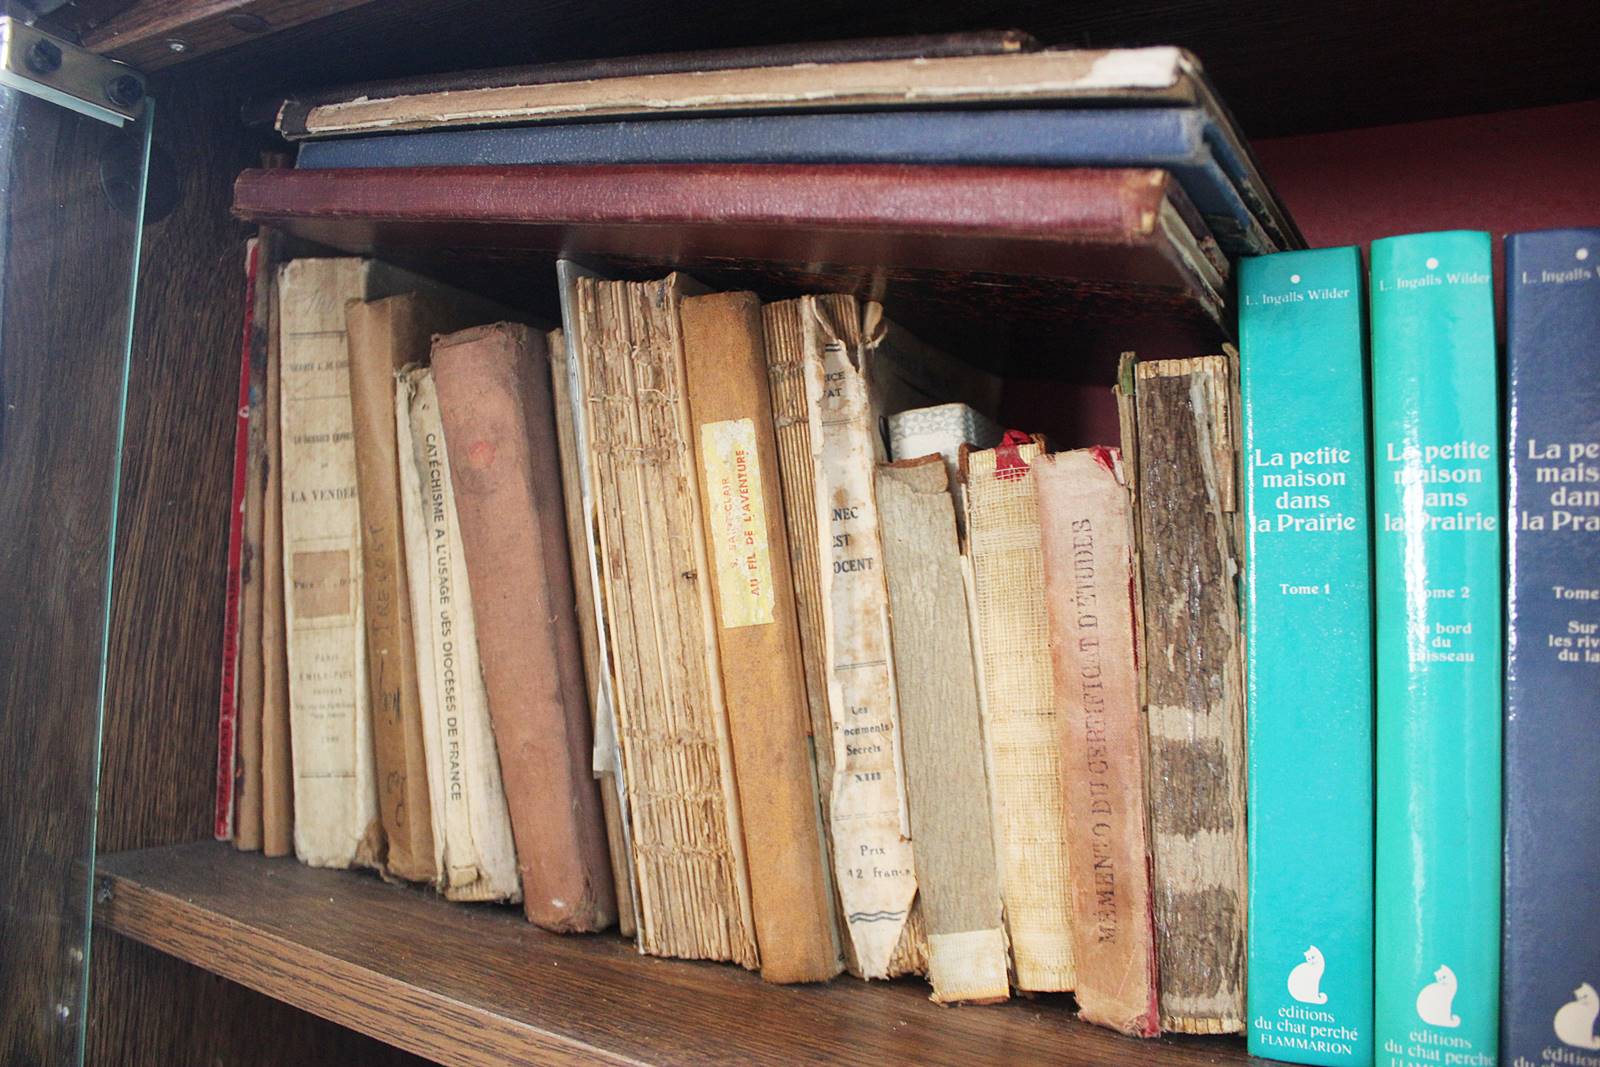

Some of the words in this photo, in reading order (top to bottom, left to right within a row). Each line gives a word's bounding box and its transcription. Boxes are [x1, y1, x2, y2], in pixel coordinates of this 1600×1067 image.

[1397, 273, 1442, 289] Ingalls
[1446, 272, 1490, 285] Wilder
[1263, 291, 1303, 305] Ingalls
[1308, 288, 1350, 300] Wilder
[1255, 449, 1283, 466] La
[1290, 447, 1350, 469] petite
[1424, 441, 1490, 463] petite
[1528, 439, 1561, 459] La
[425, 433, 445, 522] CATÉCHISME
[1263, 470, 1345, 488] maison
[1536, 462, 1600, 483] mais
[736, 449, 753, 522] L'AVENTURE
[1276, 492, 1330, 509] dans
[1550, 486, 1600, 506] dan
[1277, 513, 1356, 532] Prairie
[1384, 512, 1404, 531] la
[1521, 510, 1544, 530] la
[434, 528, 445, 539] A
[745, 530, 754, 545] DE
[748, 552, 758, 570] FIL
[436, 544, 450, 604] L'USAGE
[750, 578, 760, 596] AU
[1279, 583, 1319, 595] Tome
[1324, 583, 1330, 595] 1
[1461, 586, 1470, 598] 2
[1552, 586, 1600, 599] Tome
[1436, 622, 1472, 634] bord
[1567, 620, 1598, 634] Sur
[1432, 636, 1451, 648] du
[1548, 634, 1572, 647] les
[1558, 648, 1579, 662] du
[1079, 638, 1109, 774] CERTIFICT
[447, 717, 458, 737] DE
[449, 742, 461, 801] FRANCE
[1090, 782, 1112, 815] DU
[860, 844, 886, 856] Prix
[1254, 1016, 1272, 1030] du
[1276, 1019, 1307, 1034] chat
[1261, 1033, 1352, 1055] FLAMMARION
[1384, 1039, 1403, 1054] du
[1407, 1044, 1440, 1061] chat
